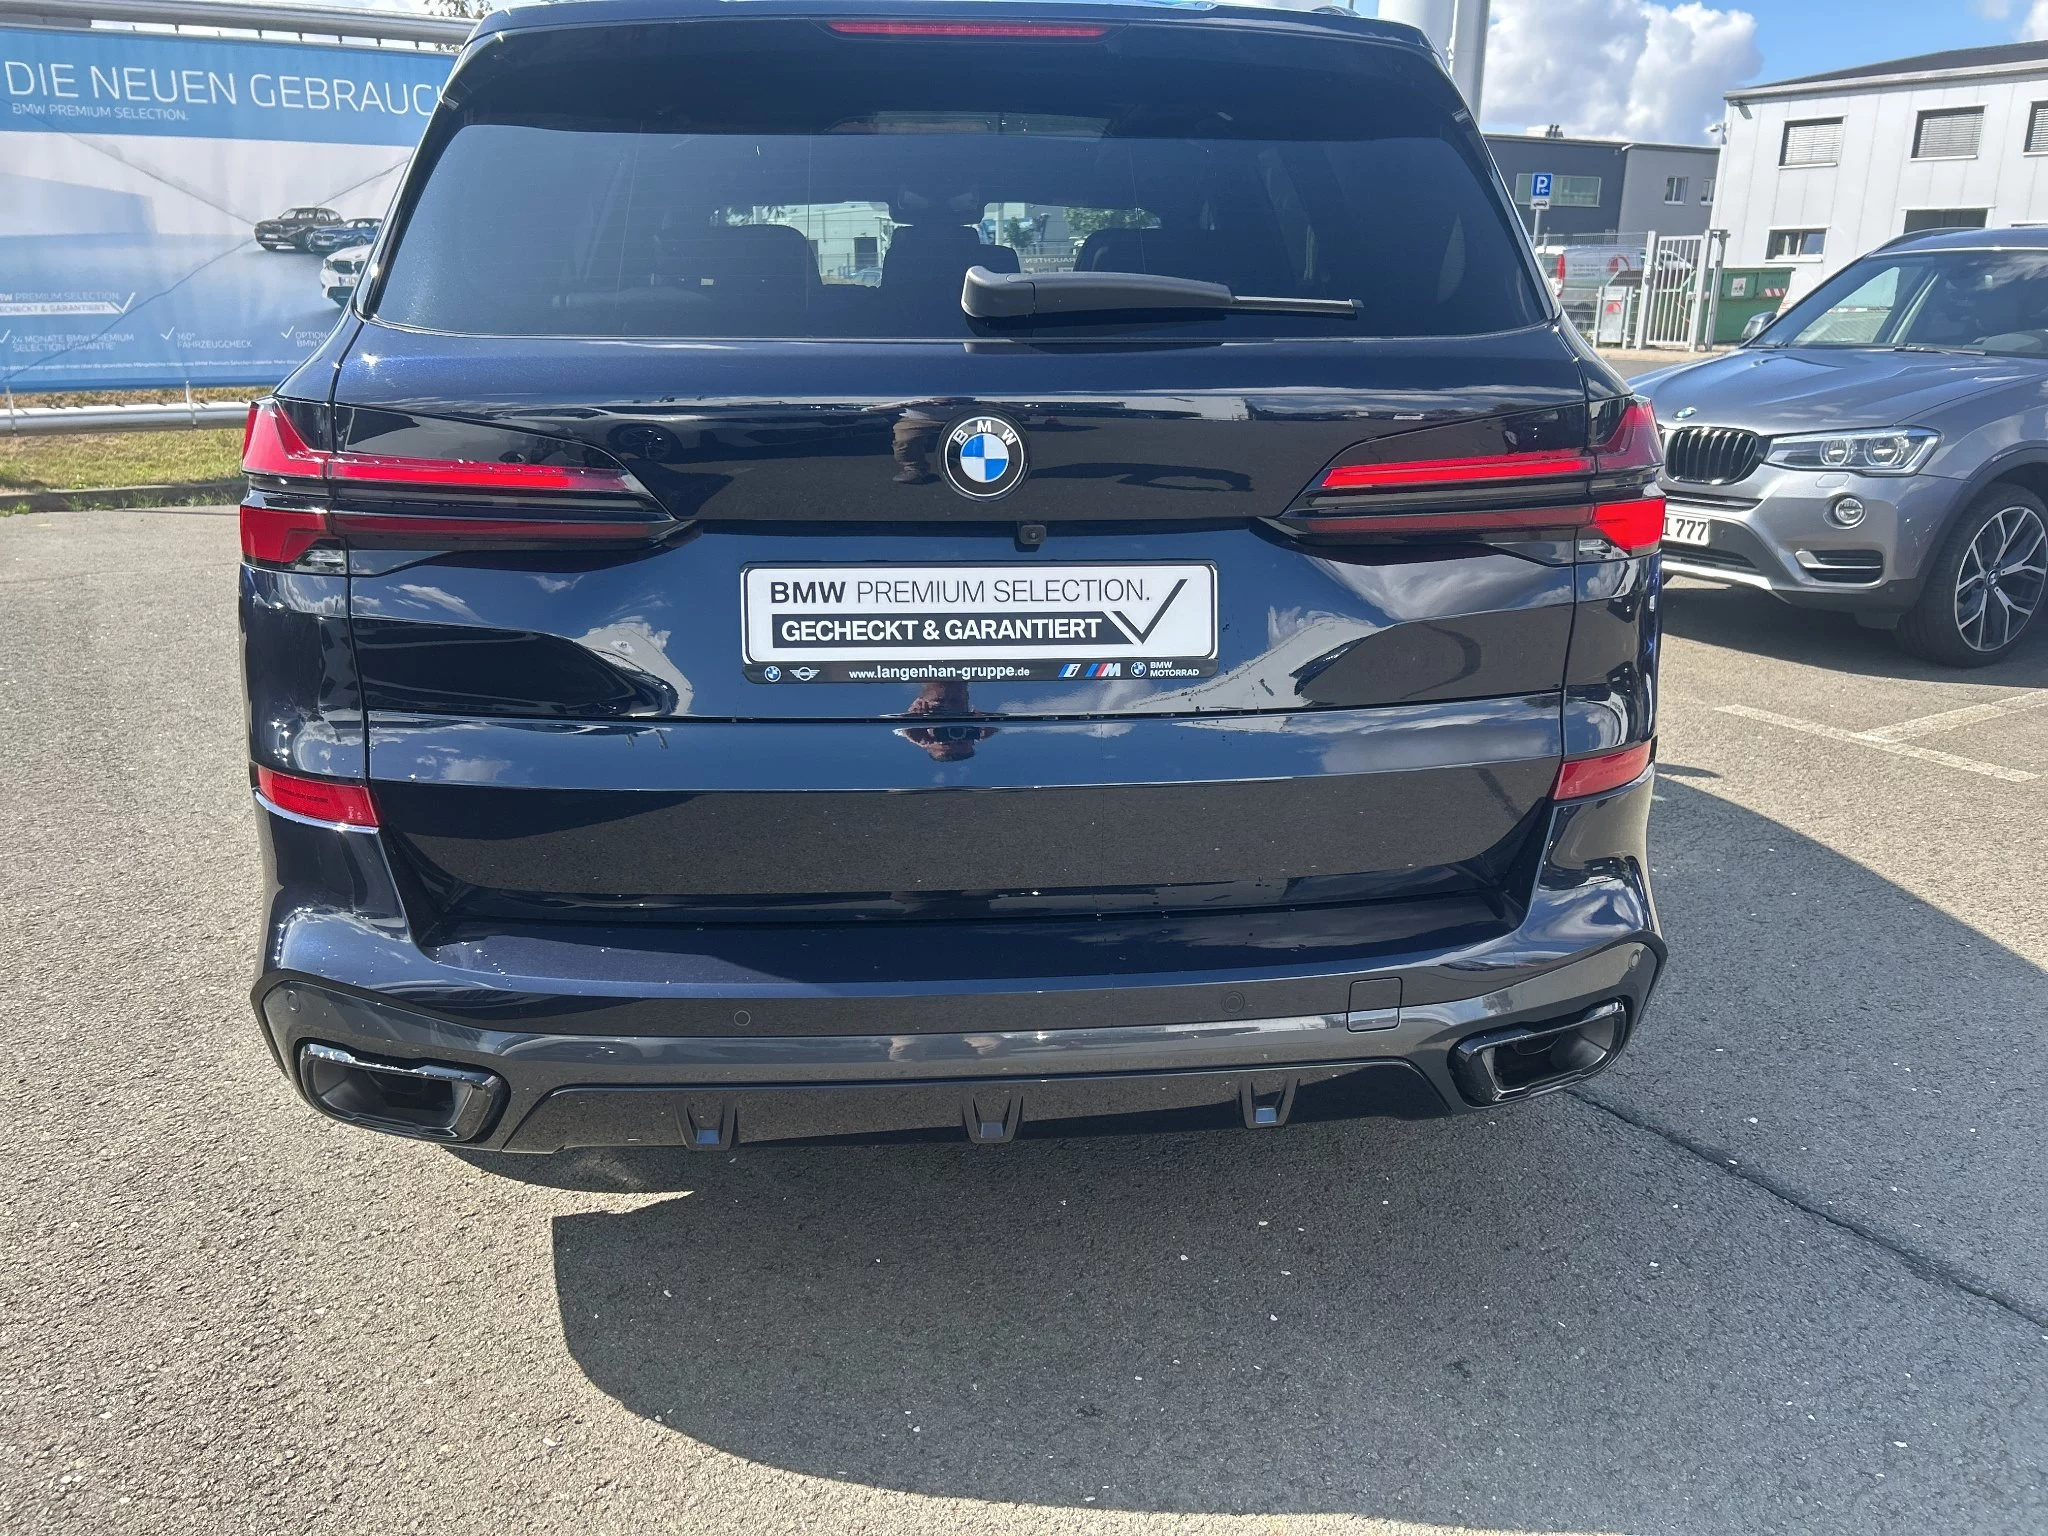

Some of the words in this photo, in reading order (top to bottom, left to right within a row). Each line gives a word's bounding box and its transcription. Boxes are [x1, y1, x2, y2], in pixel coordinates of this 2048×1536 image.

[4, 60, 80, 98] DIE
[90, 65, 237, 106] NEUEN
[250, 73, 443, 117] GEBRAUC
[12, 102, 46, 115] BMW
[49, 104, 112, 119] PREMIUM
[1536, 175, 1548, 194] P
[295, 331, 329, 340] OPTION
[952, 420, 1018, 447] BMW
[1676, 518, 1708, 541] 777
[770, 581, 847, 605] BMW
[856, 579, 986, 604] PREMIUM
[993, 578, 1151, 603] SELECTION.
[781, 620, 919, 642] GECHECKT
[922, 620, 941, 641] &
[944, 618, 1103, 641] GARANTIERT
[848, 664, 1030, 681] www.langenhan-gruppe.de
[1150, 661, 1173, 670] BMW
[1150, 668, 1200, 678] MOTORRAD
